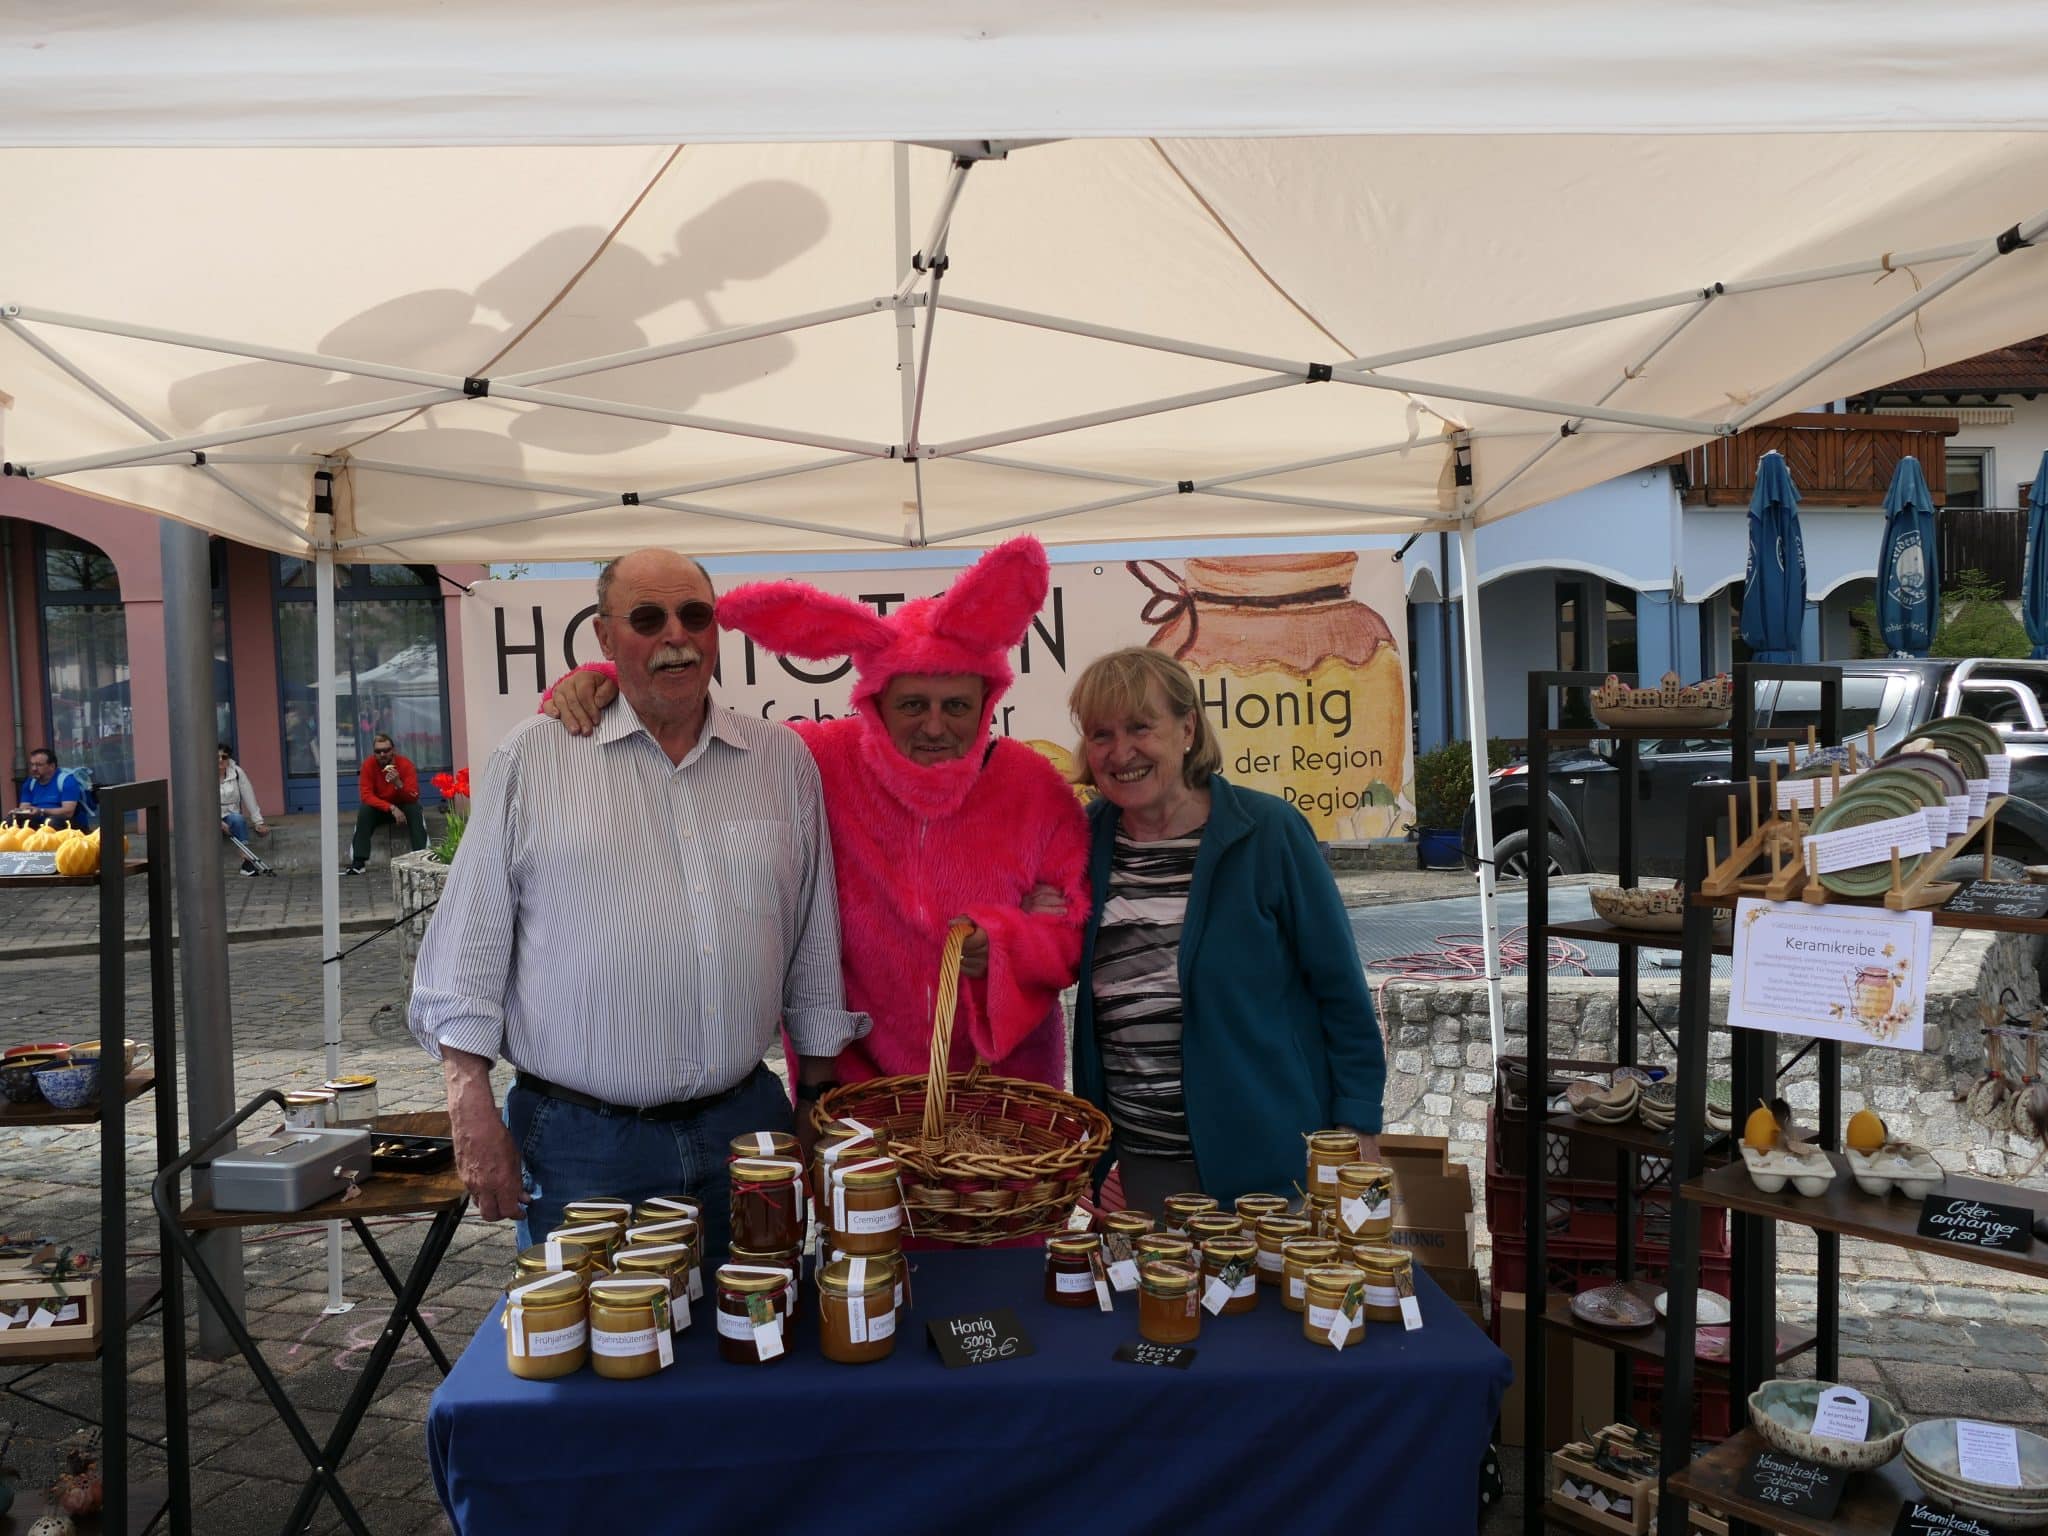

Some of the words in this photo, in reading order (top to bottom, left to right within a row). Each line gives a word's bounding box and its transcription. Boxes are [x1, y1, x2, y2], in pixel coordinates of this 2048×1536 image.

[1199, 677, 1352, 738] Honig
[1235, 748, 1280, 774] der
[1292, 746, 1382, 776] Region
[1785, 936, 1876, 957] Keramikreibe
[1947, 1201, 2000, 1220] Oster-
[1930, 1214, 2019, 1238] anhänger
[1940, 1229, 1977, 1241] 1,50
[950, 1317, 996, 1338] Honig
[961, 1336, 992, 1350] 500g
[1137, 1344, 1182, 1357] Honig
[1757, 1454, 1831, 1485] Keramikreibe
[1754, 1472, 1813, 1500] Schüssel
[1911, 1504, 1990, 1536] Keramikreibe
